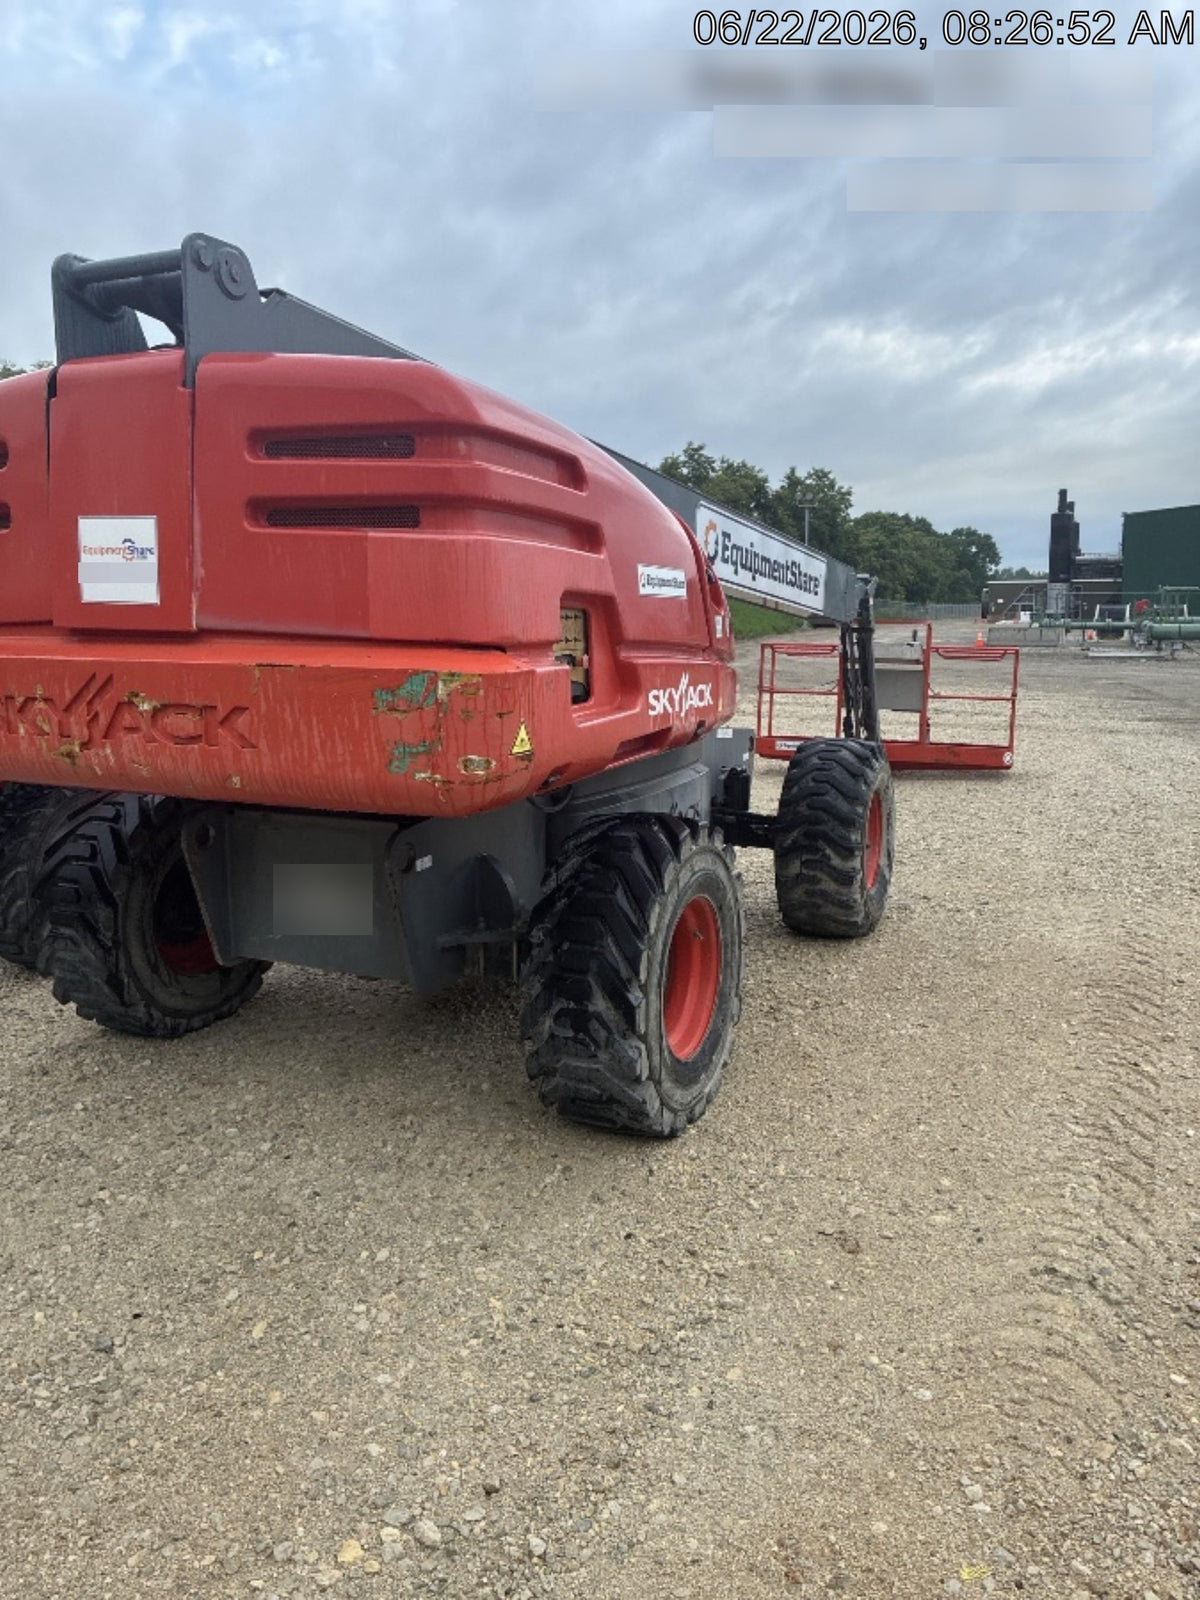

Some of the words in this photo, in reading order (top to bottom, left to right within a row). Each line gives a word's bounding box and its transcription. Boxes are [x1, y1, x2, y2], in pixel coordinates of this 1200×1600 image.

[721, 530, 821, 596] EquipmentShare
[0, 672, 258, 752] KYJACK
[648, 672, 713, 717] SKYJACK
